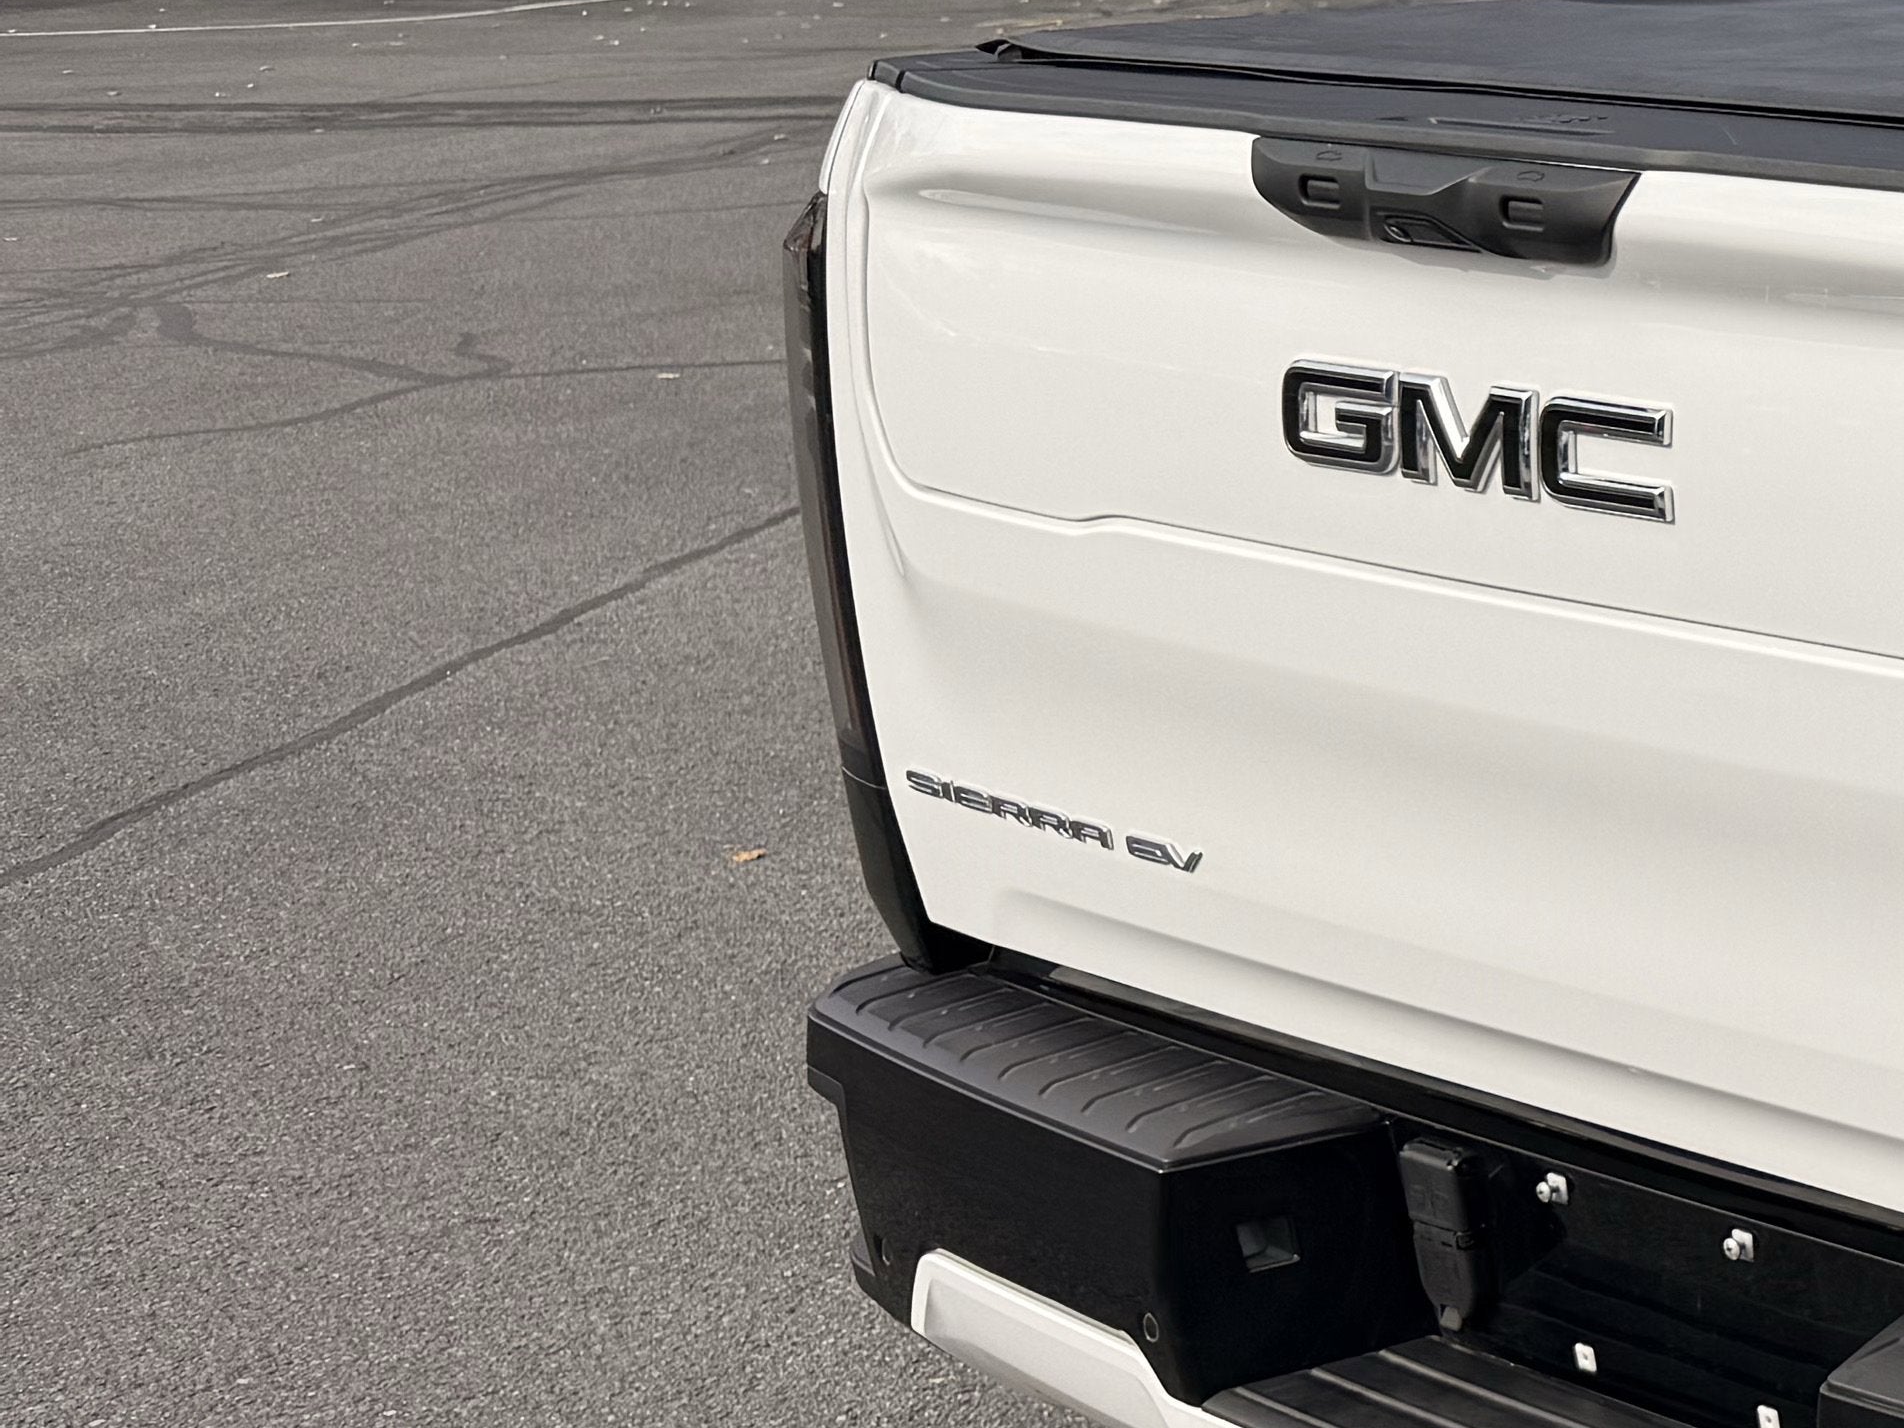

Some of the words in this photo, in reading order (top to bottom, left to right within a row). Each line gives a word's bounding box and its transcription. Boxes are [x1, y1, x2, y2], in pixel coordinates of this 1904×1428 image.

[1282, 358, 1676, 525] GMC
[905, 768, 1115, 851] SIERRA
[1125, 833, 1203, 874] EV
